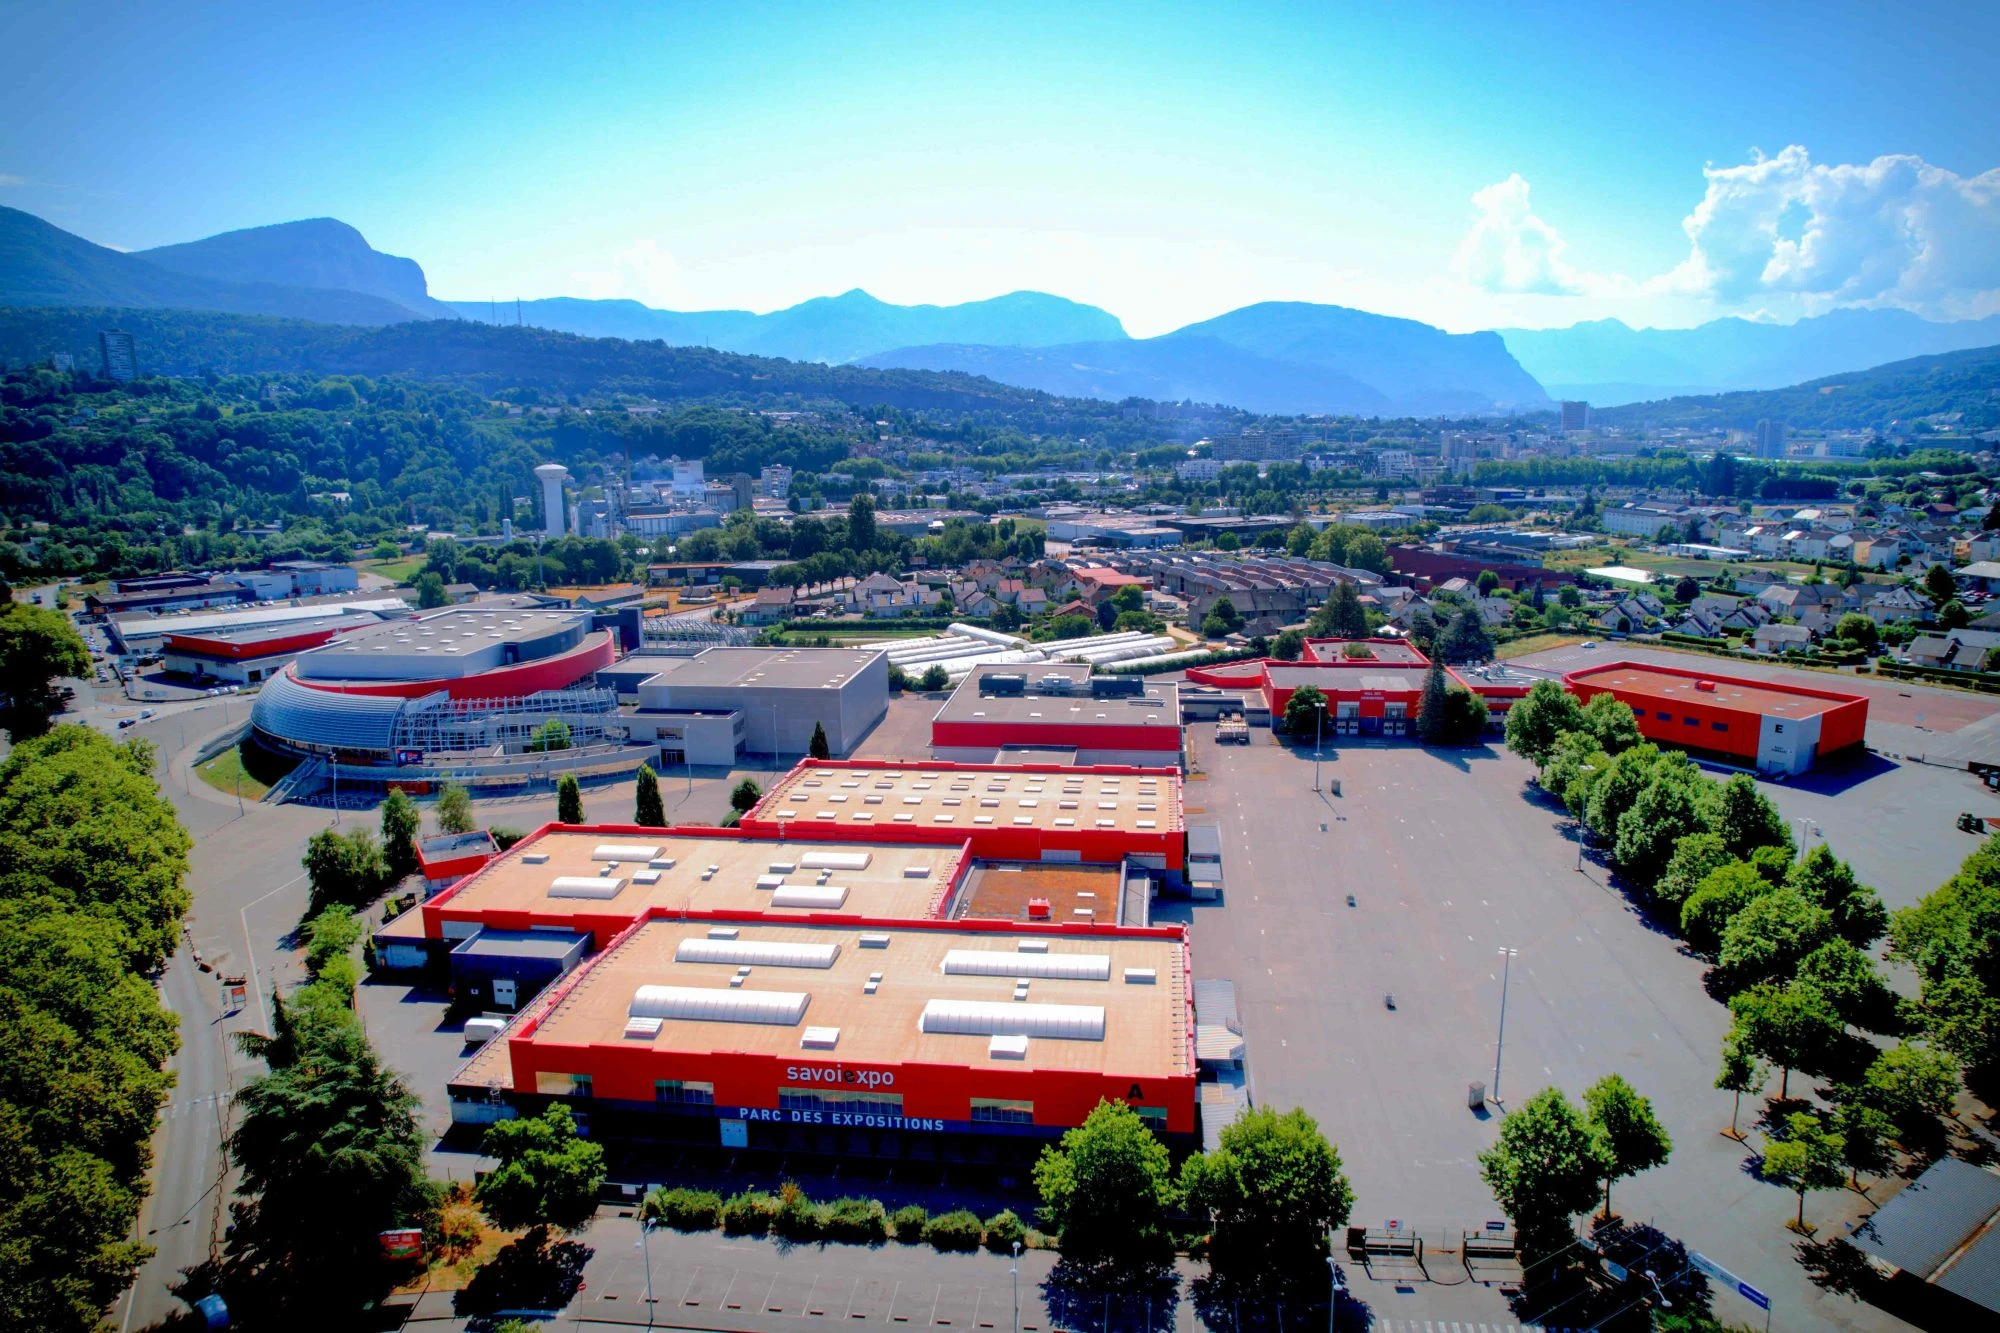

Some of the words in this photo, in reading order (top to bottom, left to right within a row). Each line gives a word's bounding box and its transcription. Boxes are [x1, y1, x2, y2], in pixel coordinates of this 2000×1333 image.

[1775, 724, 1784, 734] E
[787, 1064, 894, 1089] savoiexpo
[1127, 1082, 1145, 1100] A
[740, 1107, 781, 1121] PARC
[791, 1110, 822, 1124] DES
[832, 1112, 944, 1131] EXPOSITIONS
